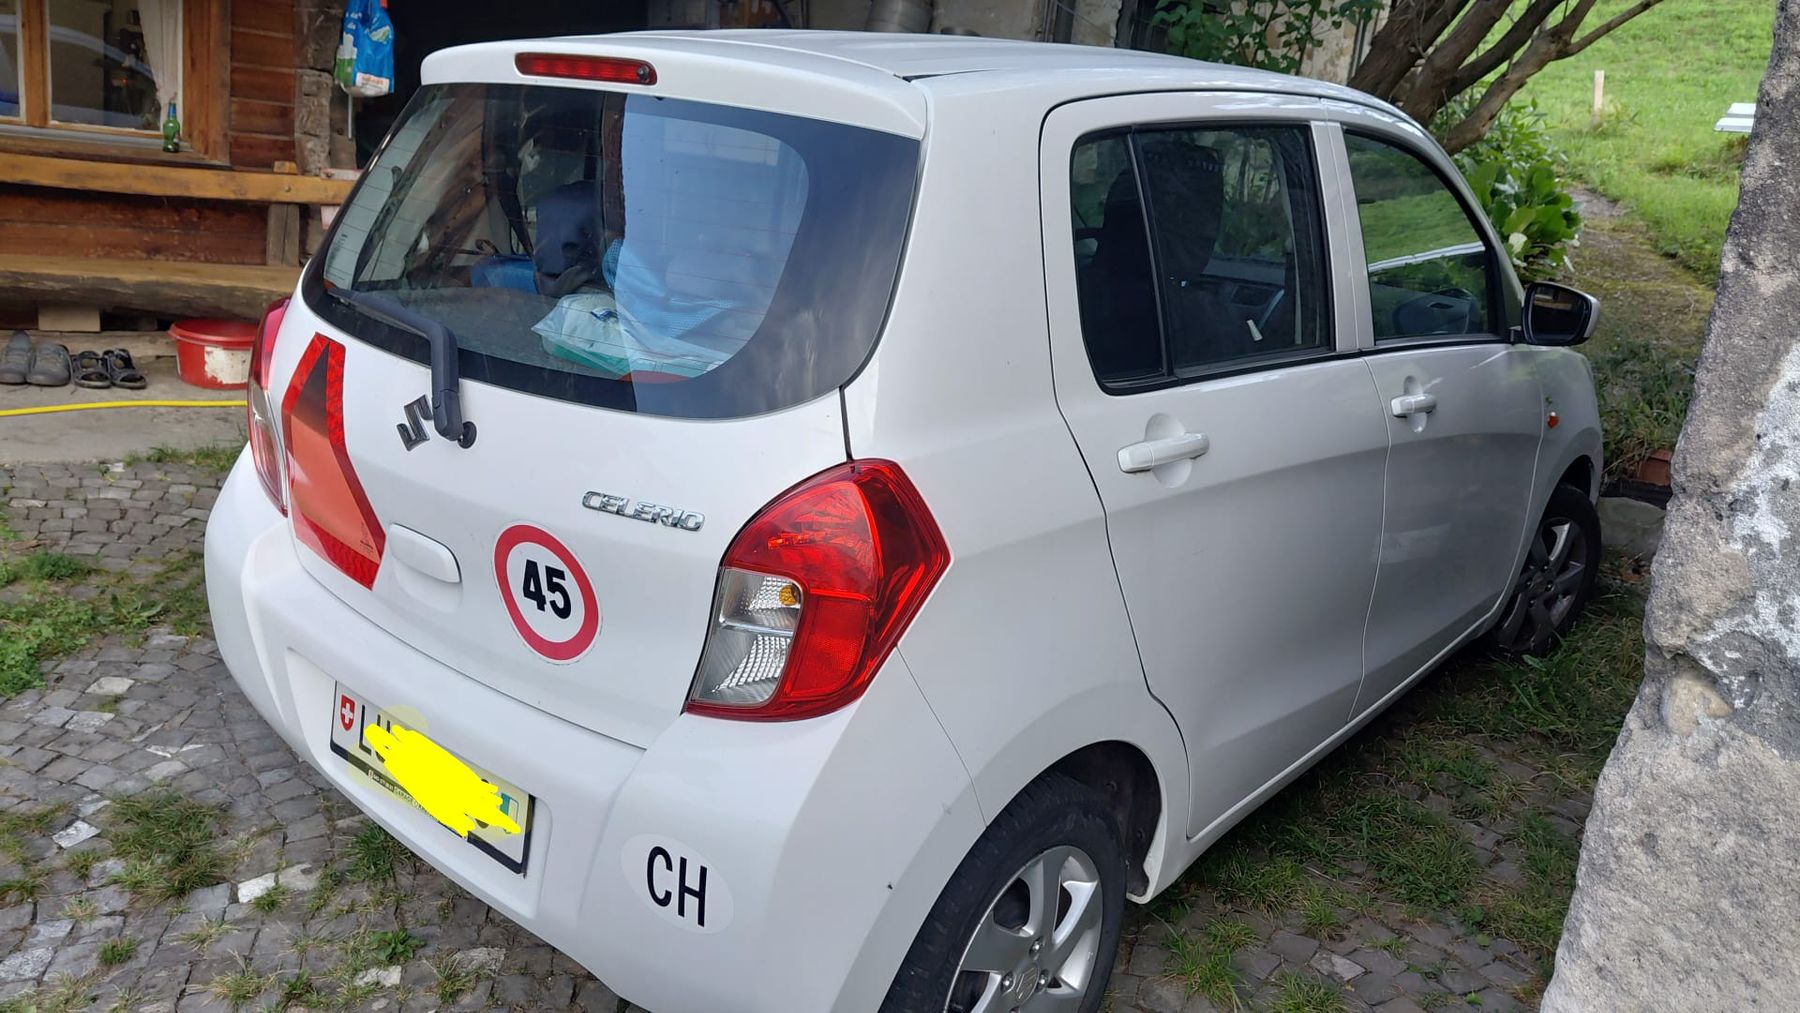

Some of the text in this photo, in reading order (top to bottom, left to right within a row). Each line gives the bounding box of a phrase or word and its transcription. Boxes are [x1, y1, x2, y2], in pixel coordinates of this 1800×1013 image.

[582, 491, 706, 532] CELERIO
[522, 559, 572, 620] 45
[646, 846, 708, 928] CH
